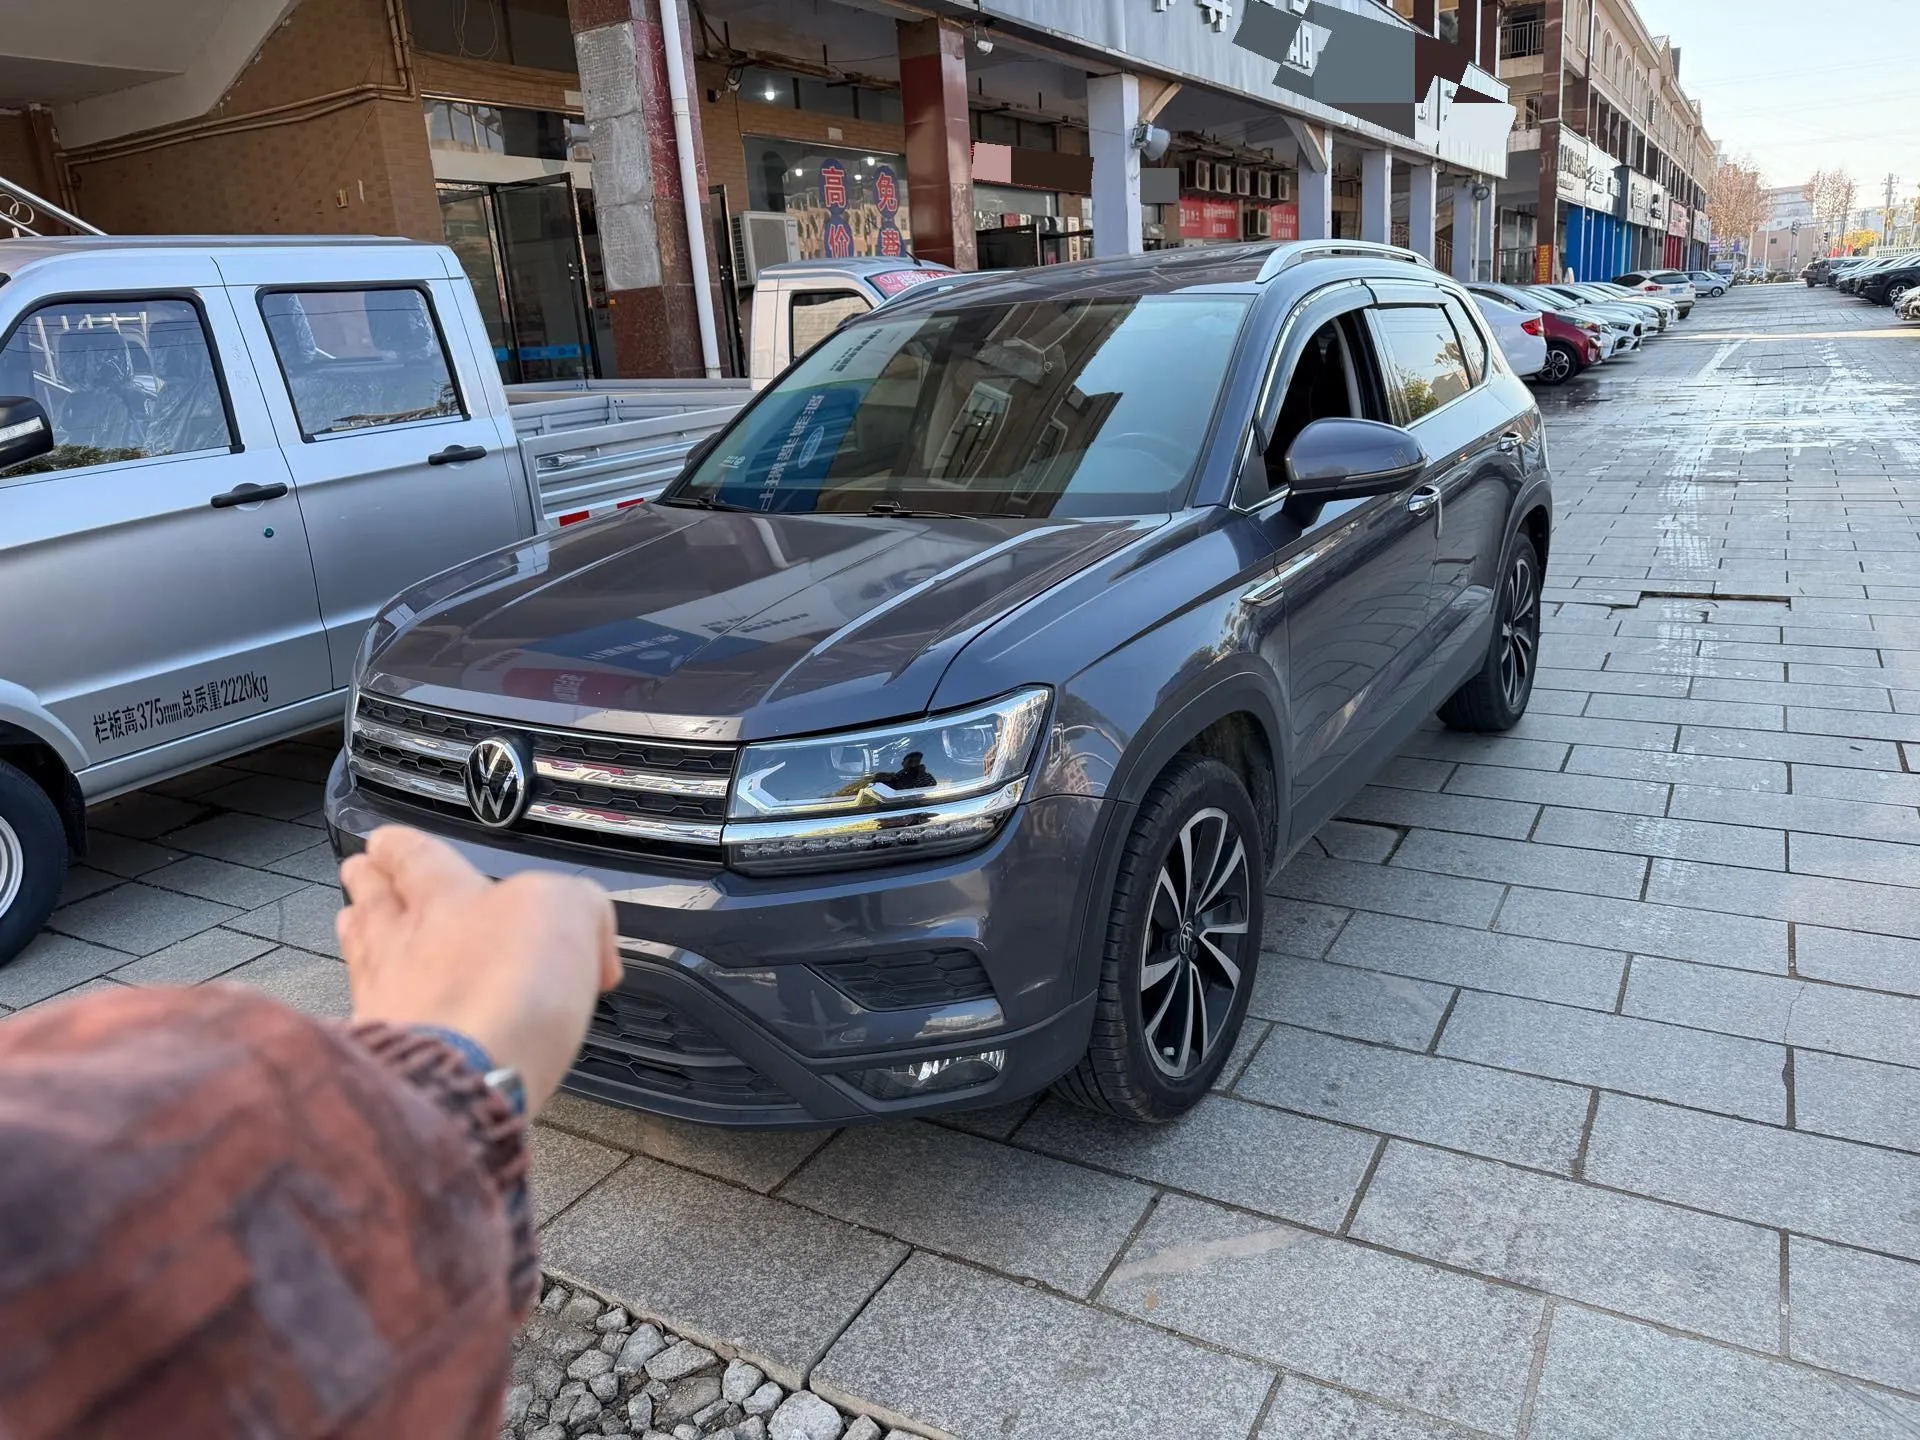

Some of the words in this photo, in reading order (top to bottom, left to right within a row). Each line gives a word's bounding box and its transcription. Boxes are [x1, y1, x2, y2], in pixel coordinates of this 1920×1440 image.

[821, 165, 850, 258] 高价
[93, 671, 269, 744] 栏板高375mm总质量2220kg
